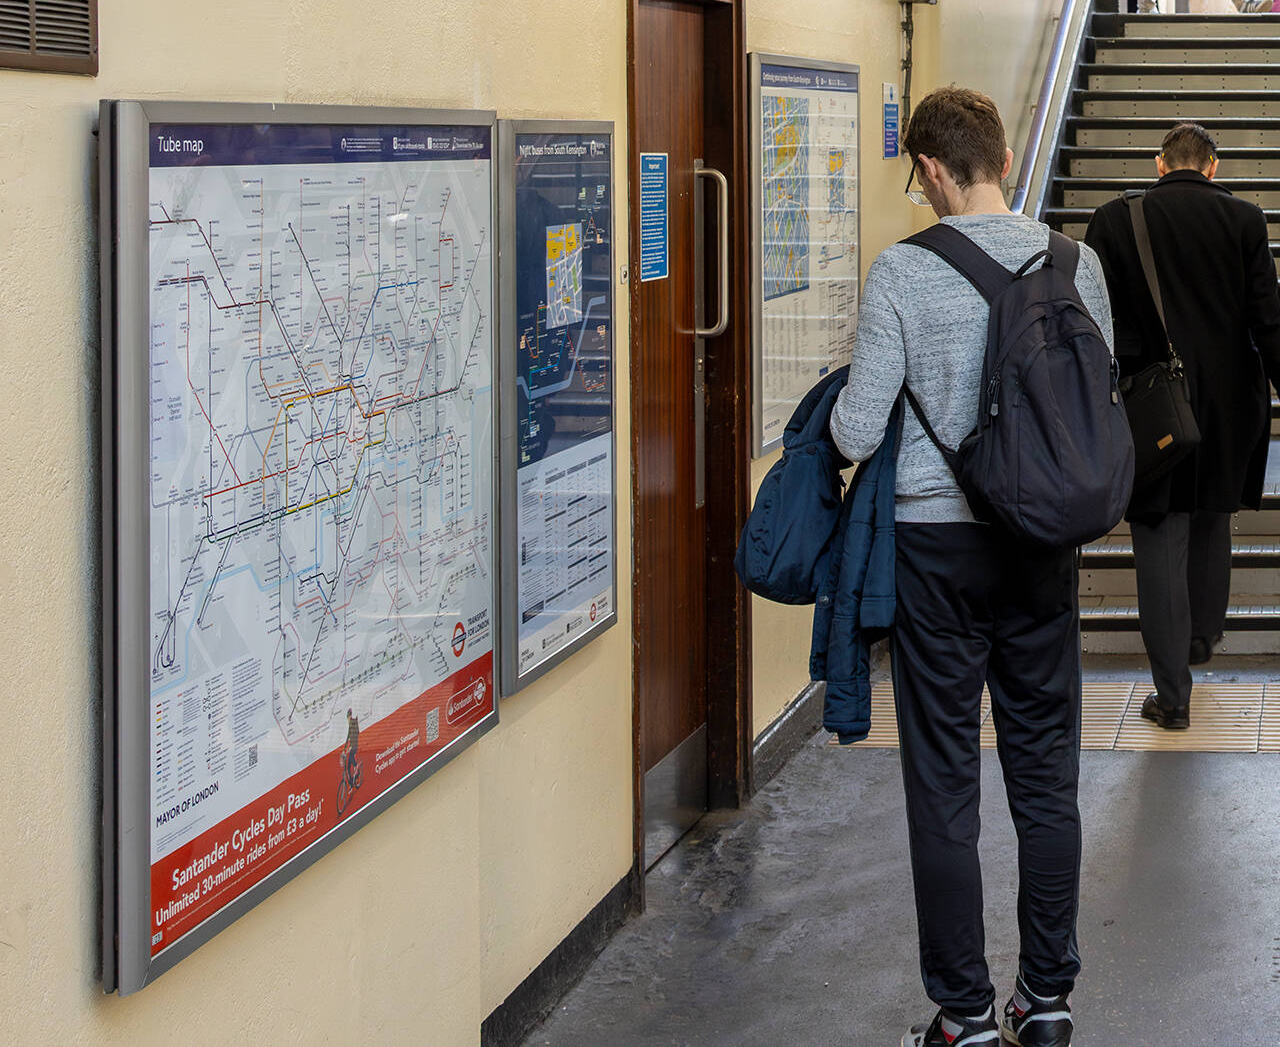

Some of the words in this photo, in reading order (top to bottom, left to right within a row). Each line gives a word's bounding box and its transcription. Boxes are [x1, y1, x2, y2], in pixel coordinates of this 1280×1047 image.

[158, 136, 180, 152] Tube
[183, 138, 204, 155] map
[156, 804, 181, 828] MAYOR
[181, 798, 191, 812] OF
[191, 780, 219, 807] LONDON
[172, 841, 229, 891] Santander
[232, 818, 265, 852] Cycles
[267, 804, 285, 828] Day
[288, 788, 310, 813] Pass
[155, 882, 200, 927] Unlimited
[202, 857, 245, 895] 30-minute
[246, 842, 267, 865] rides
[268, 829, 285, 850] from
[287, 818, 297, 836] £3
[299, 817, 304, 829] a
